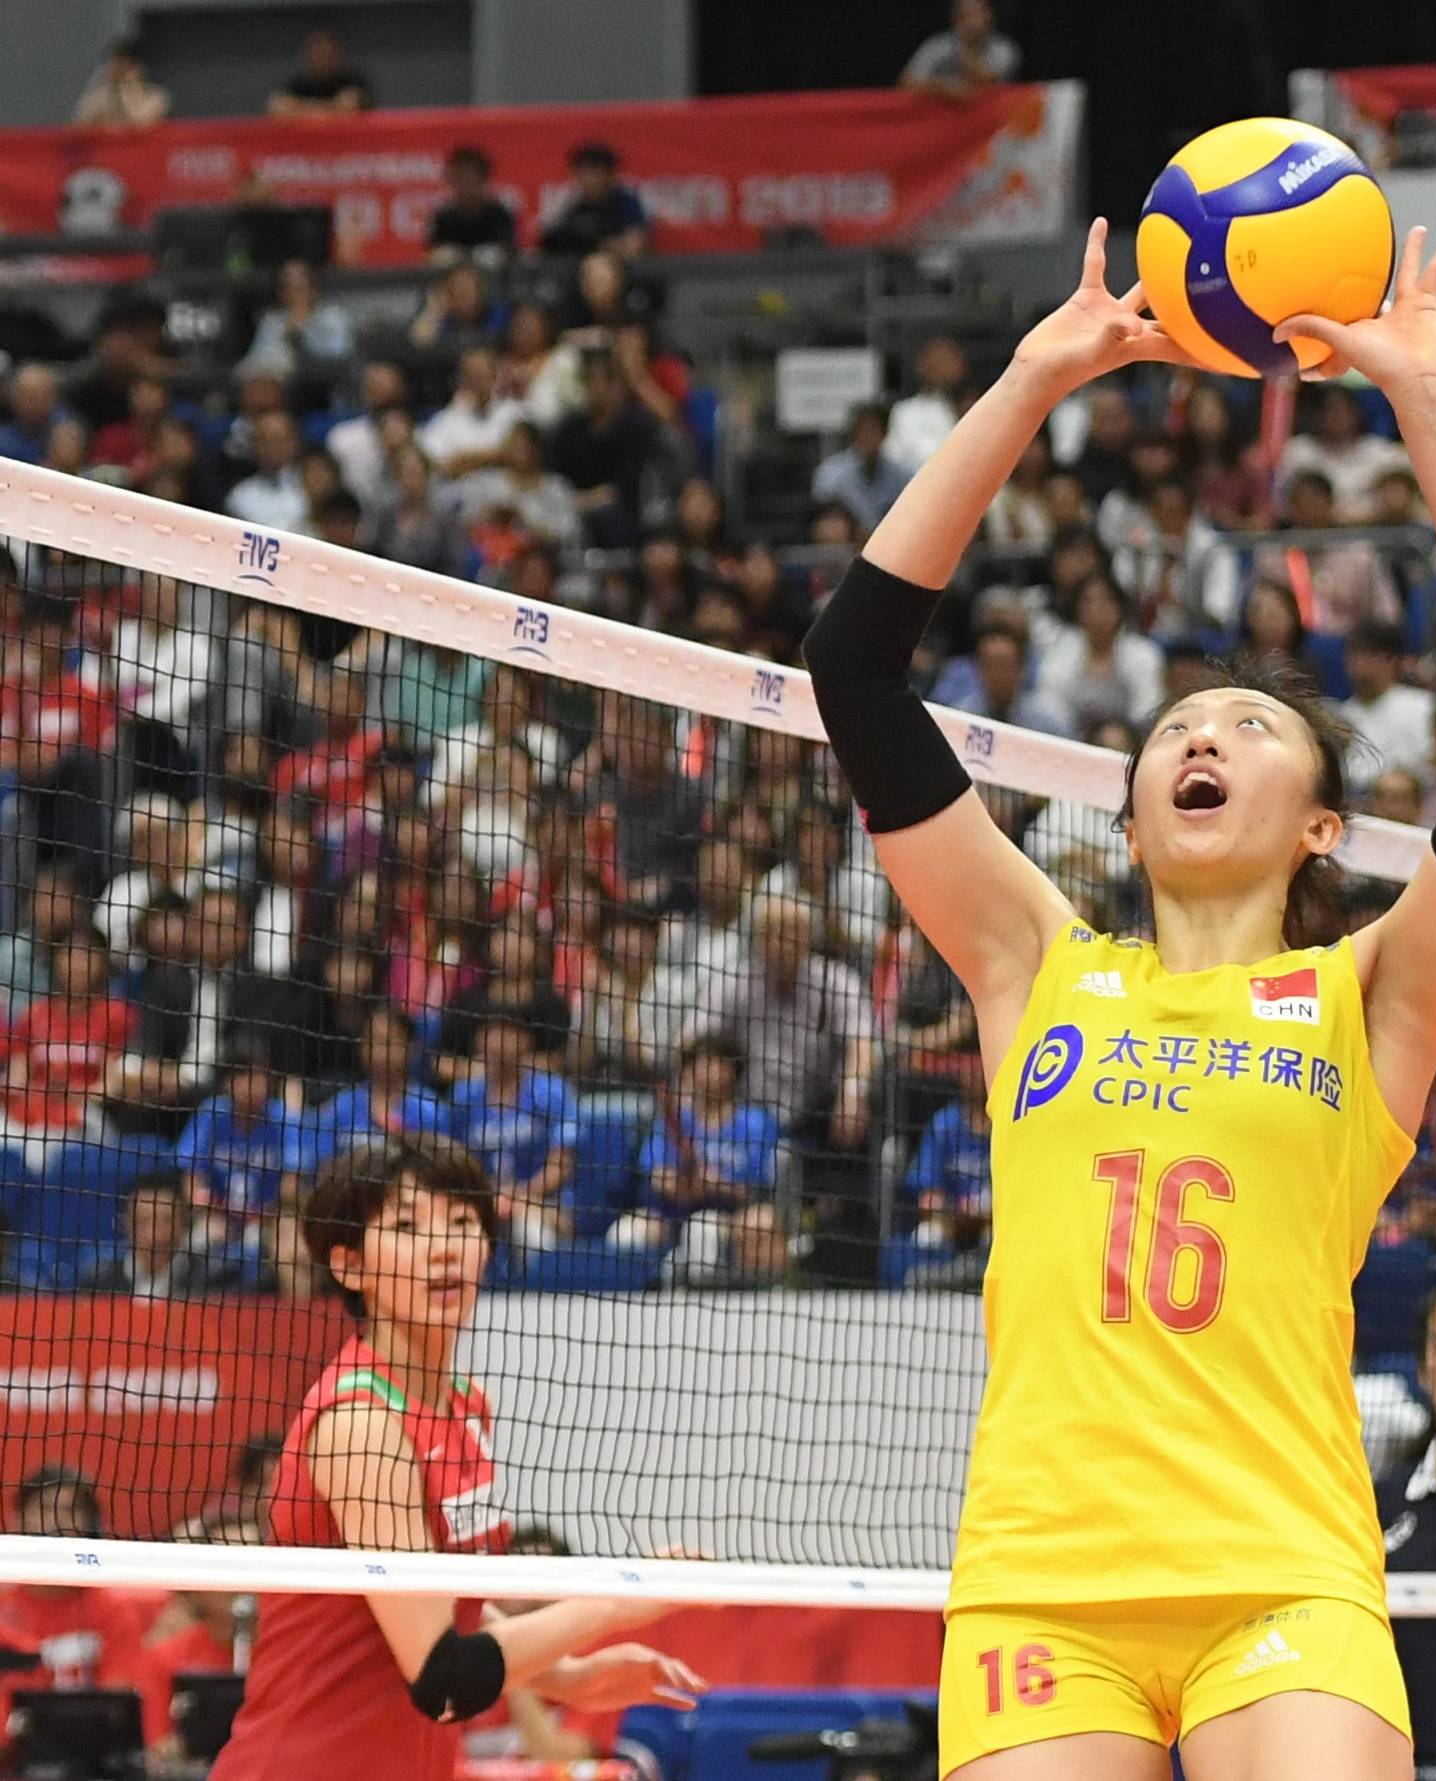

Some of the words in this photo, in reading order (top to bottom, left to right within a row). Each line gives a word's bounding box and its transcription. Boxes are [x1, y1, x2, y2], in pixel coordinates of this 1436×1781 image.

[1258, 1003, 1313, 1019] CHN
[1092, 1077, 1192, 1113] CPIC
[1098, 1028, 1344, 1112] 太平洋保险
[1091, 1148, 1236, 1335] 16
[975, 1642, 1057, 1717] 16
